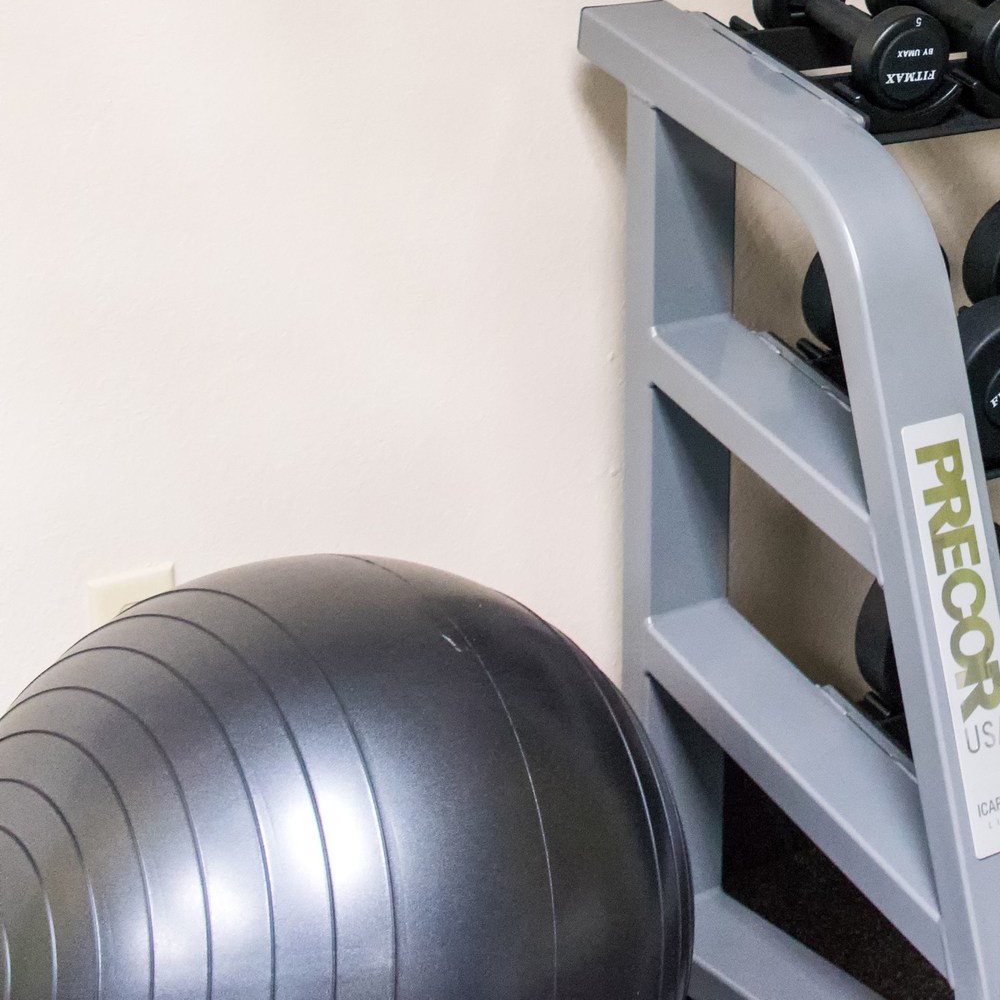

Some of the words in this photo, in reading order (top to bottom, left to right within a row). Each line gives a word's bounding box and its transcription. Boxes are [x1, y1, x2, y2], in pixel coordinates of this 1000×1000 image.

[916, 17, 922, 27] 5
[897, 49, 920, 57] UMAX
[885, 70, 936, 84] FITMAX
